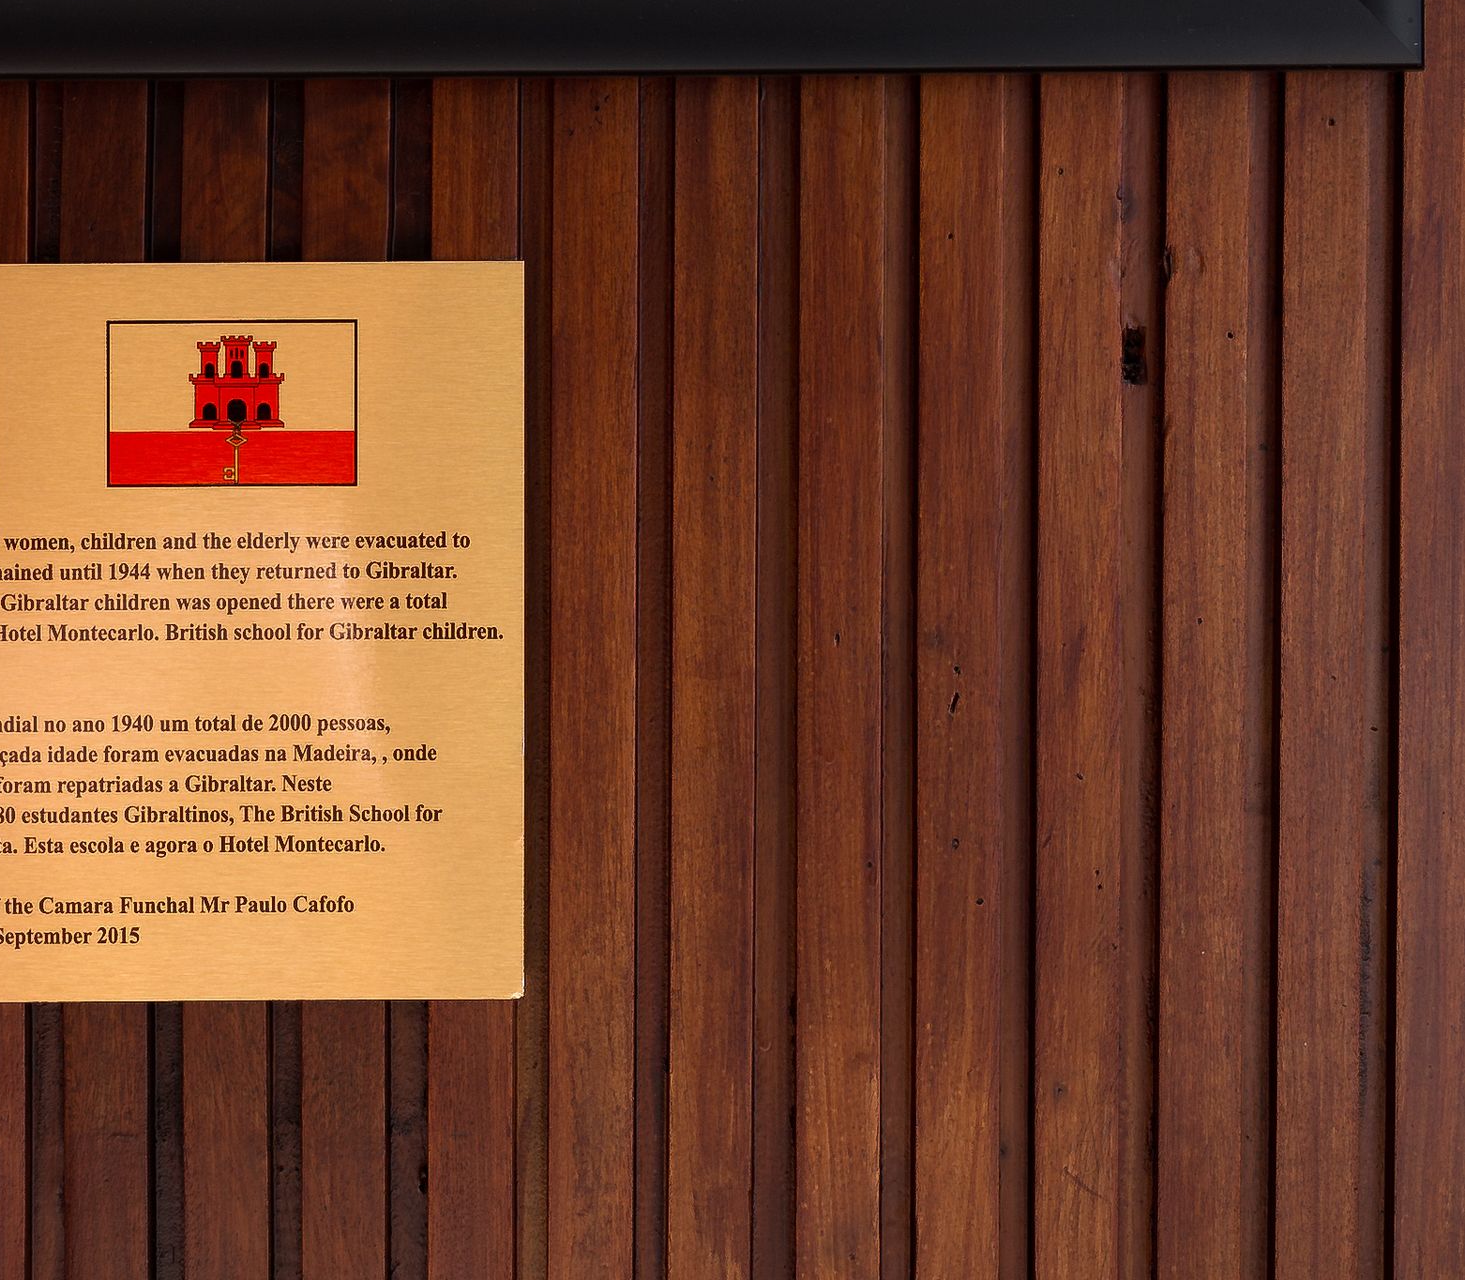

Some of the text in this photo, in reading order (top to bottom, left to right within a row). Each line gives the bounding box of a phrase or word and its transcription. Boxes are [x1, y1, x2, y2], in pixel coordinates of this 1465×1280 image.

[3, 537, 75, 554] women,
[80, 532, 157, 551] children
[162, 531, 198, 550] and
[202, 531, 232, 550] the
[236, 531, 301, 554] elderly
[305, 535, 350, 549] were
[355, 530, 448, 549] evacuated
[451, 531, 471, 549] to
[59, 562, 103, 581] until
[108, 562, 151, 581] 1944
[156, 562, 206, 581] when
[210, 562, 251, 585] they
[255, 561, 337, 580] returned
[342, 563, 361, 580] to
[365, 560, 458, 580] Gibraltar.
[0, 593, 90, 612] Gibraltar
[94, 592, 171, 611] children
[175, 597, 211, 611] was
[216, 592, 282, 616] opened
[286, 592, 335, 610] there
[340, 596, 385, 610] were
[389, 596, 401, 610] a
[405, 591, 448, 610] total
[47, 623, 160, 642] Montecarlo.
[164, 622, 229, 641] British
[233, 622, 292, 641] school
[296, 622, 325, 641] for
[329, 622, 418, 641] Gibraltar
[422, 621, 504, 640] children.
[43, 719, 67, 733] no
[72, 719, 105, 733] ano
[111, 714, 154, 733] 1940
[159, 719, 190, 733] um
[194, 713, 237, 732] total
[241, 713, 264, 732] de
[268, 713, 312, 732] 2000
[316, 718, 391, 737] pessoas,
[47, 745, 99, 763] idade
[102, 744, 160, 763] foram
[164, 744, 259, 763] evacuadas
[264, 748, 287, 762] na
[292, 743, 377, 766] Madeira,
[392, 743, 437, 762] onde
[56, 775, 163, 799] repatriadas
[168, 779, 180, 793] a
[184, 774, 277, 793] Gibraltar.
[281, 774, 332, 792] Neste
[21, 806, 118, 824] estudantes
[123, 804, 235, 827] Gibraltinos,
[238, 804, 276, 823] The
[280, 804, 344, 823] British
[349, 803, 411, 823] School
[414, 803, 444, 822] for
[23, 836, 65, 855] Esta
[69, 835, 125, 854] escola
[129, 840, 140, 854] e
[144, 840, 198, 859] agora
[202, 840, 214, 853] o
[218, 835, 270, 853] Hotel
[274, 834, 386, 853] Montecarlo.
[3, 897, 34, 915] the
[38, 896, 114, 915] Camara
[118, 896, 195, 914] Funchal
[199, 895, 231, 914] Mr
[234, 895, 288, 914] Paulo
[292, 894, 355, 913] Cafofo
[96, 926, 140, 945] 2015
